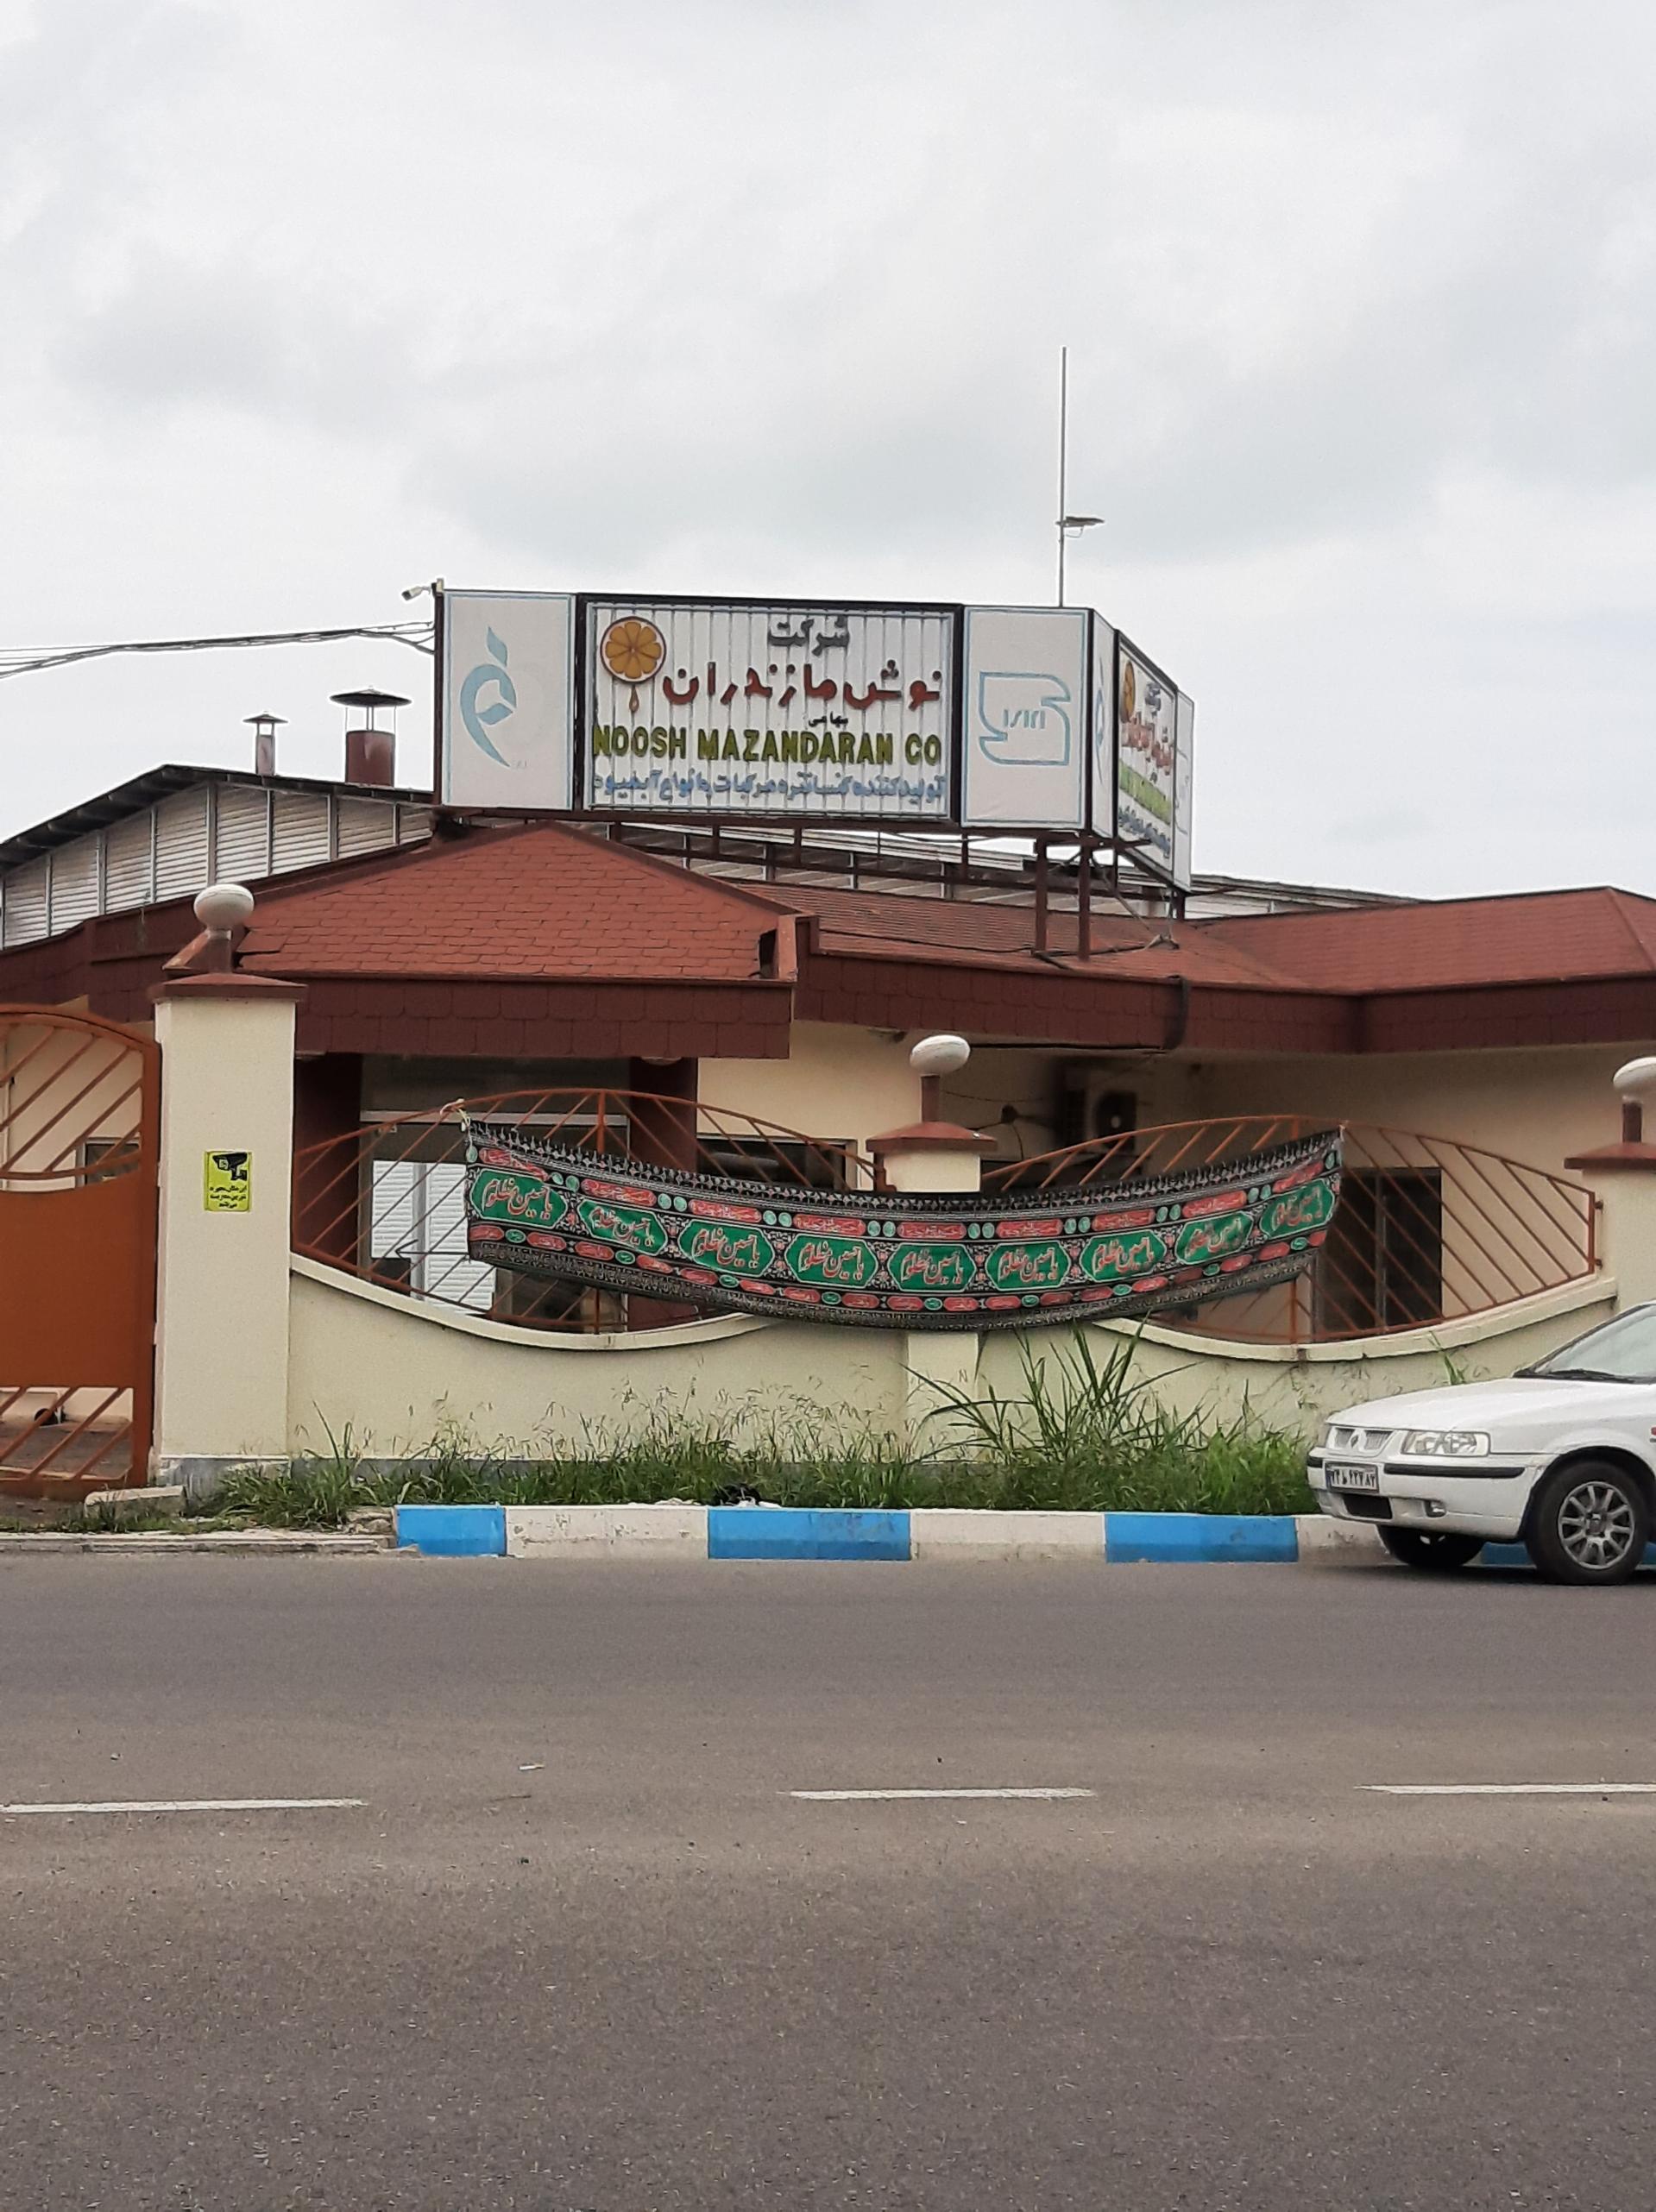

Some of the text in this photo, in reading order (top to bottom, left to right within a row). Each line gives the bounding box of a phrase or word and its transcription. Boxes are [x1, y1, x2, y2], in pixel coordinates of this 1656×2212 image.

[767, 616, 850, 656] شرکت
[662, 659, 941, 711] نوش مازندران
[593, 723, 941, 766] NOOSH MAZANDARAN CO
